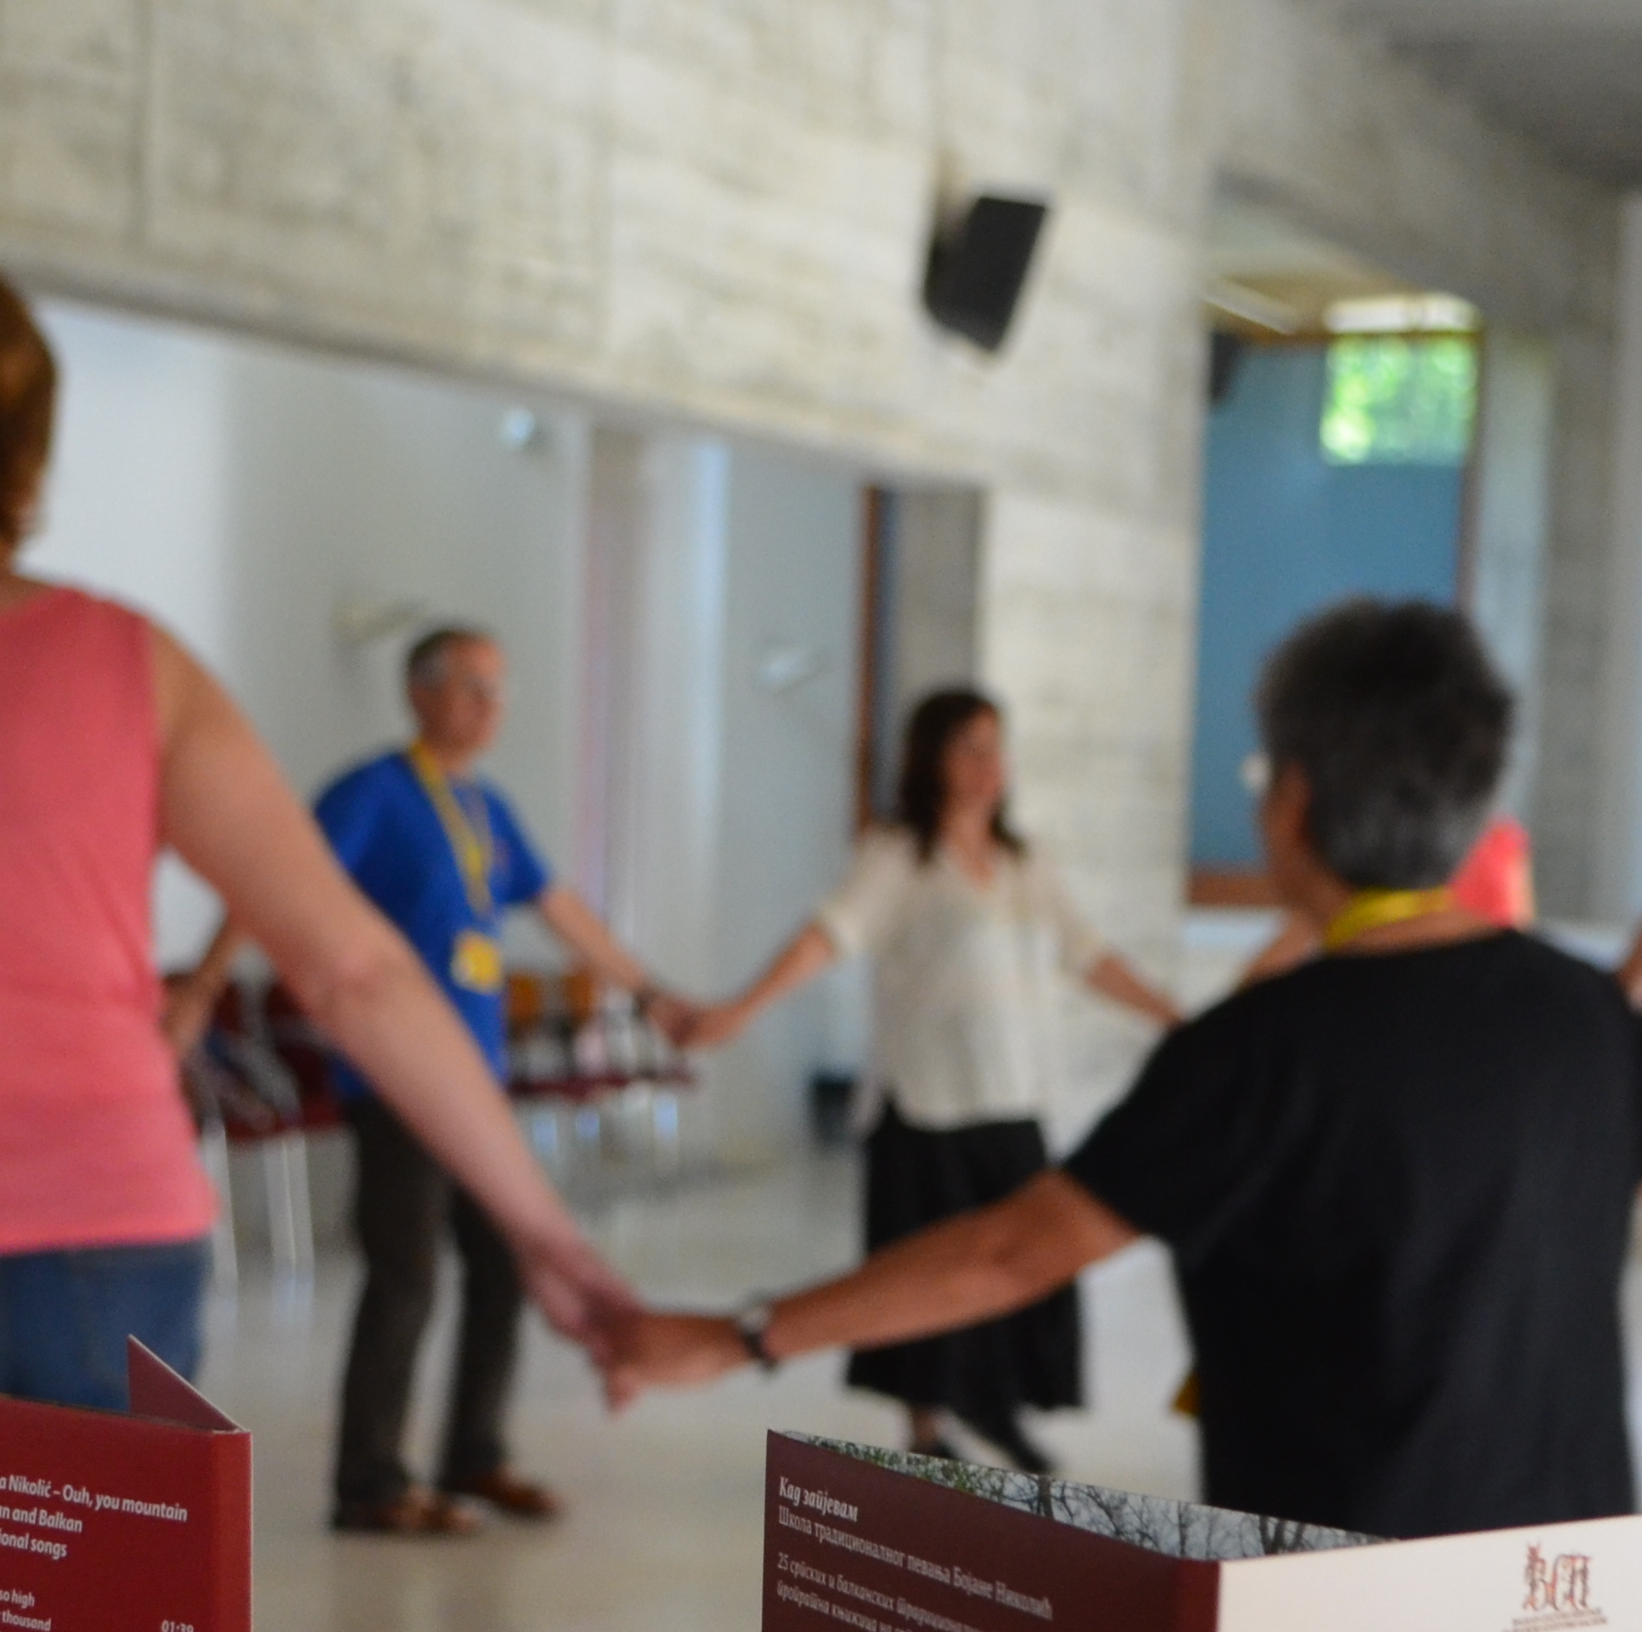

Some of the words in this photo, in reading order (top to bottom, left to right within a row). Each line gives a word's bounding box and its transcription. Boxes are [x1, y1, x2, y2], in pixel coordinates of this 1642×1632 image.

[7, 1474, 52, 1499] Nikolić
[62, 1483, 94, 1508] Ouh,
[94, 1493, 121, 1511] you
[121, 1498, 188, 1522] mountain
[11, 1507, 38, 1525] and
[38, 1508, 83, 1533] Balkan
[30, 1538, 67, 1561] songs
[10, 1588, 36, 1610] high
[0, 1609, 52, 1632] thousand
